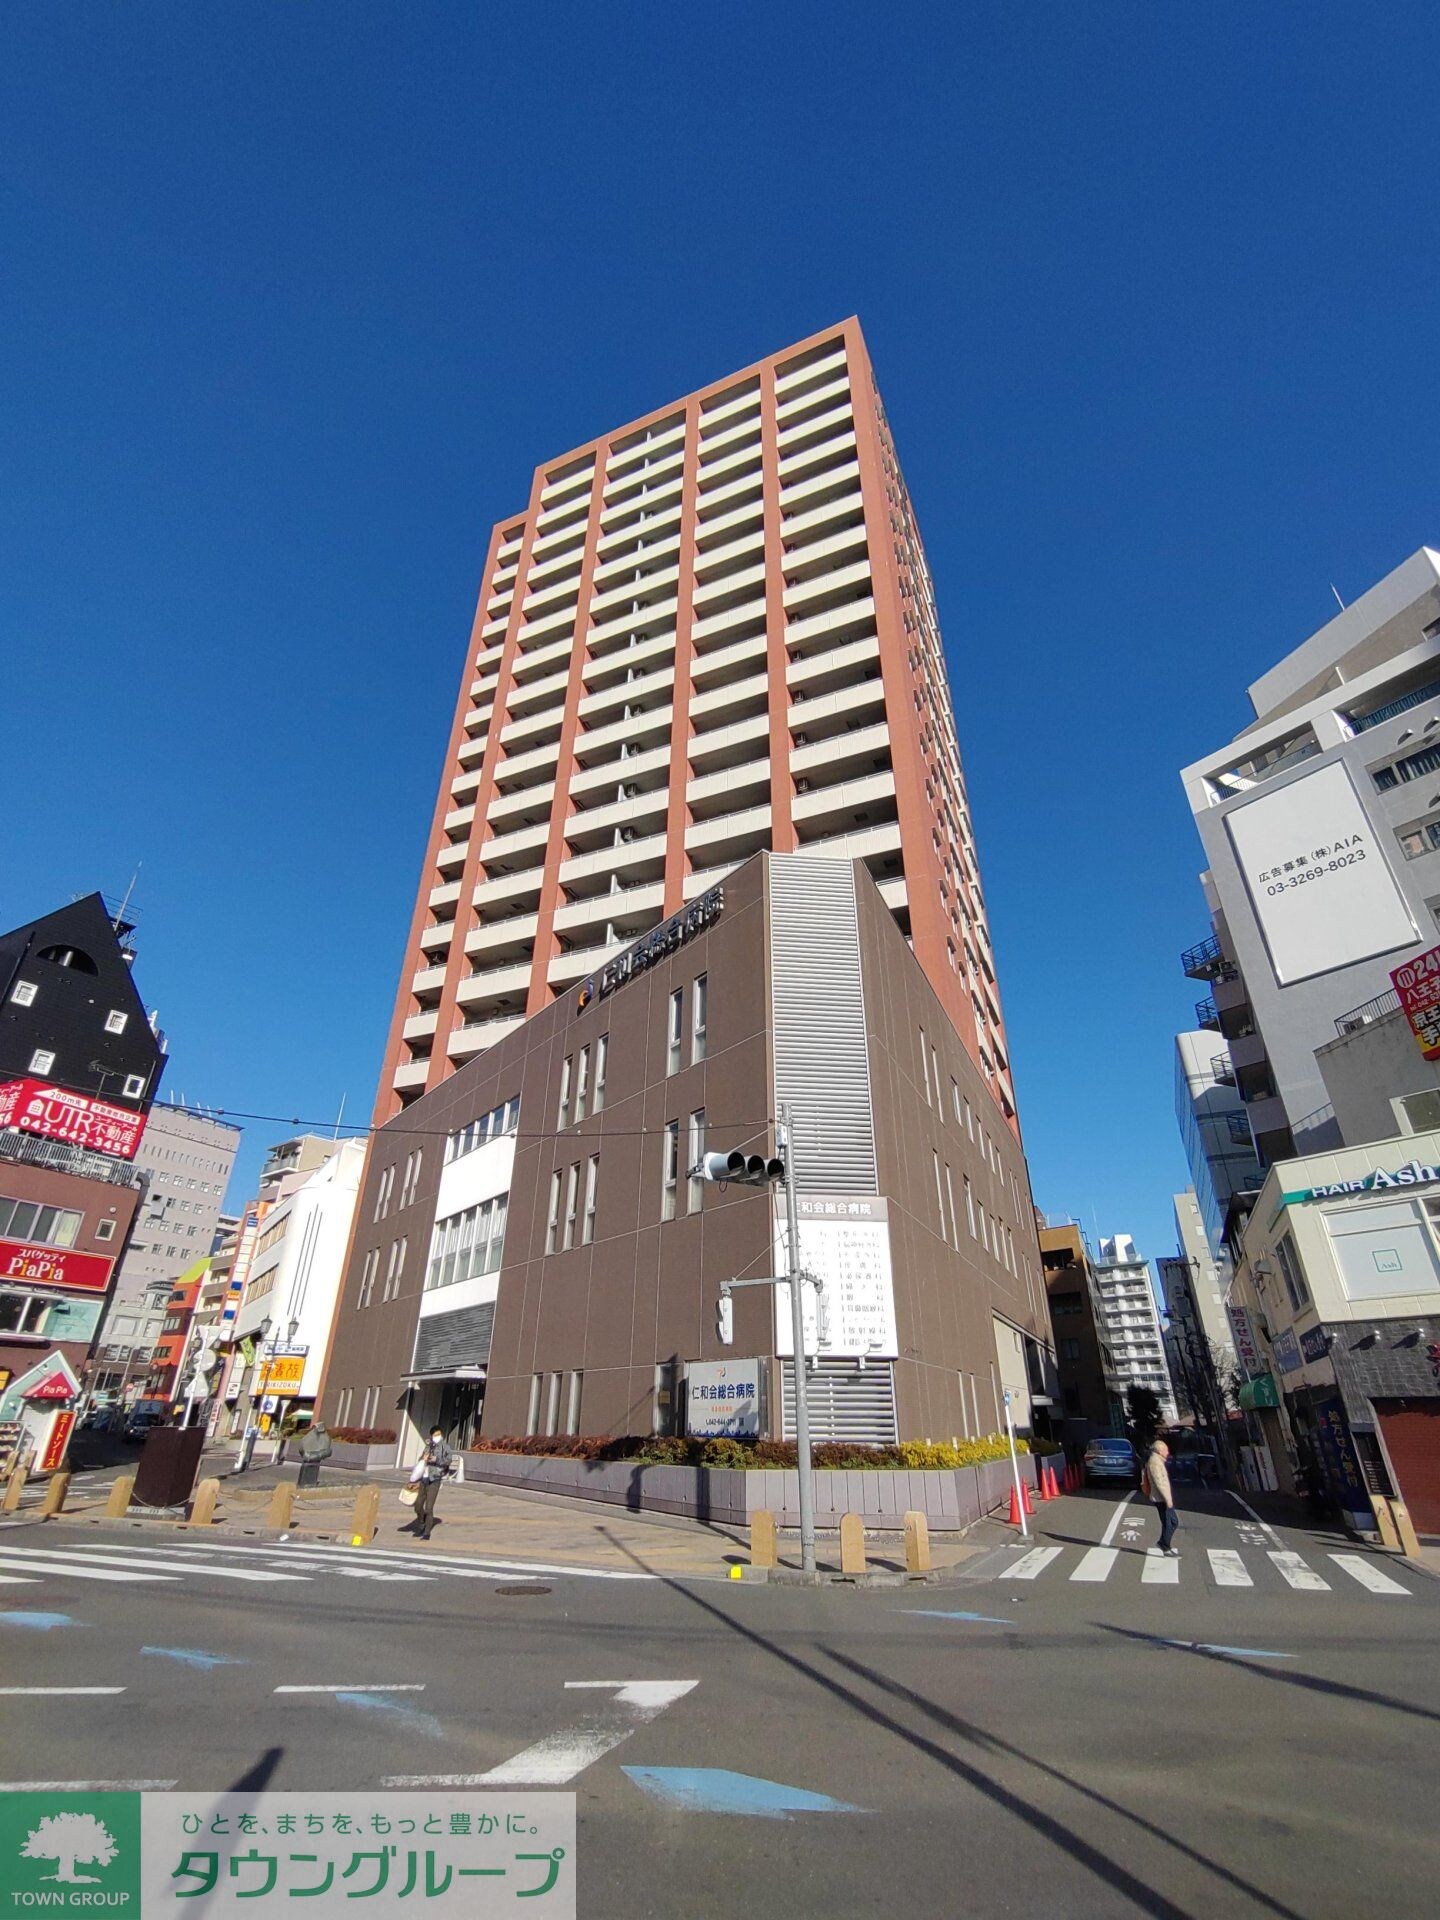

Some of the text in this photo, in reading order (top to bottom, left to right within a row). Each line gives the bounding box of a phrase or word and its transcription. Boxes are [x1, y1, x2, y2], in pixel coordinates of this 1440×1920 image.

[1259, 856, 1308, 883] 広告募集
[1267, 849, 1366, 896] 03-3269-8023
[1422, 1021, 1440, 1047] 手
[45, 1101, 94, 1133] UTR
[20, 1116, 130, 1154] 042-642-3456
[92, 1121, 136, 1146] 不動産
[1312, 1160, 1440, 1197] HAIR Ash
[6, 1257, 64, 1281] PiaPia
[1230, 1308, 1257, 1368] 処方せん受付
[259, 1381, 297, 1389] TRIKIZOKU
[692, 1383, 755, 1400] 仁和会総合病院
[46, 1415, 70, 1467] ミートソース
